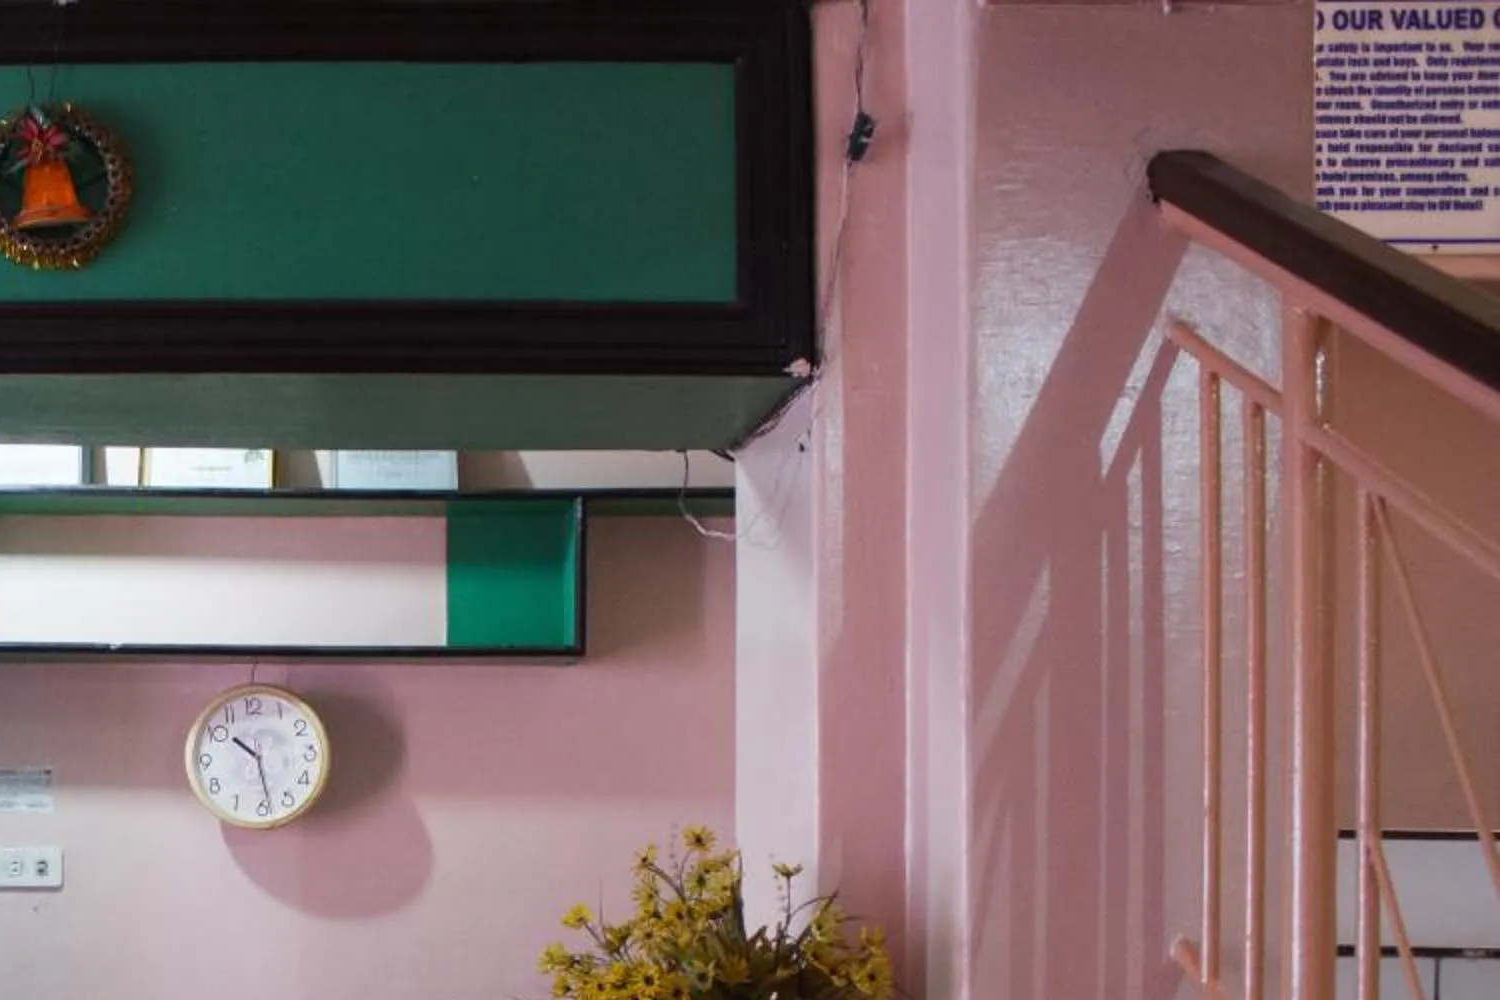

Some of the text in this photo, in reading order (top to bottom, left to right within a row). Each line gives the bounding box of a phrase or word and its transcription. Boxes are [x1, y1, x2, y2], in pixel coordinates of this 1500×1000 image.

[1332, 9, 1485, 30] OUR VALUED
[243, 696, 262, 716] 12
[206, 724, 229, 744] 10
[293, 718, 308, 737] 2
[199, 753, 213, 770] 9
[208, 777, 221, 795] 8
[297, 769, 310, 785] 4
[255, 799, 270, 817] 6
